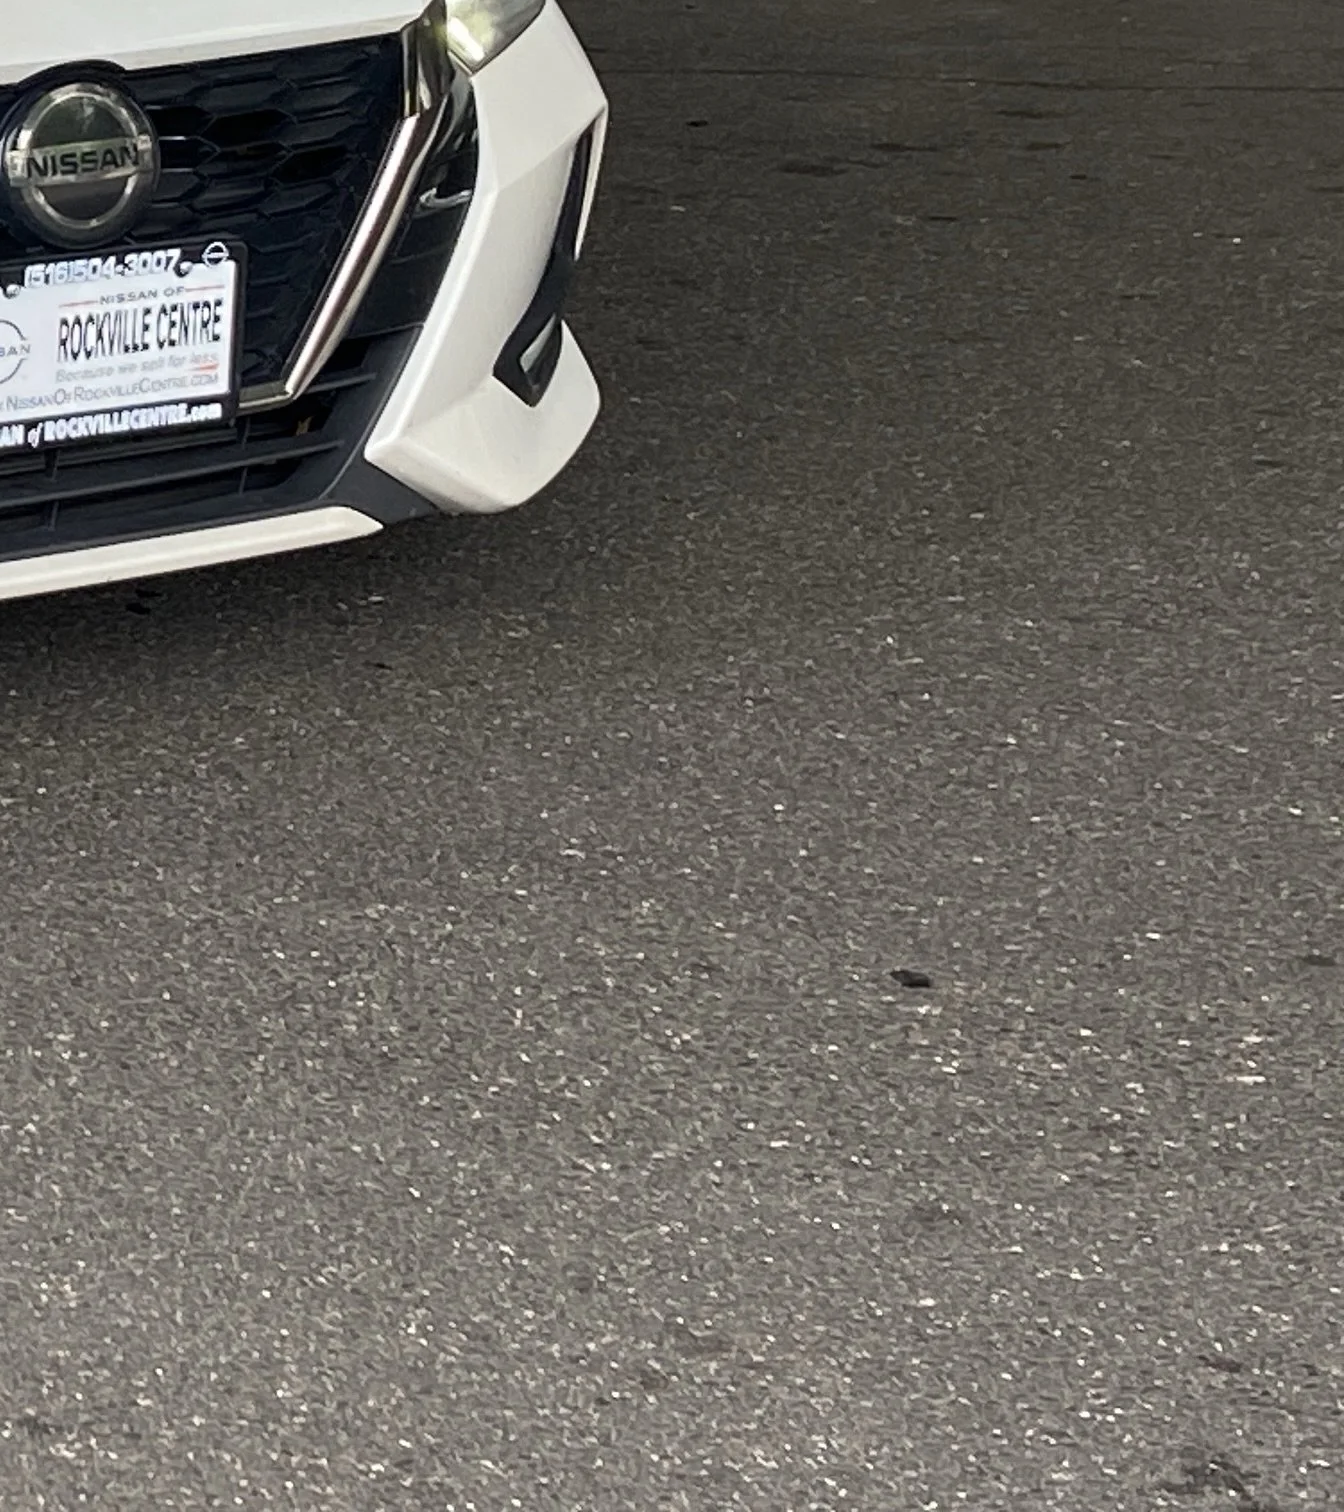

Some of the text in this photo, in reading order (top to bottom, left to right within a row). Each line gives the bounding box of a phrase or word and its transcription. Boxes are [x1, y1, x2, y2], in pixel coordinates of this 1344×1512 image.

[26, 141, 139, 178] NISSAN
[99, 285, 185, 305] NISSAN OF
[57, 297, 223, 363] ROCKVILLE CENTRE
[28, 422, 43, 448] of
